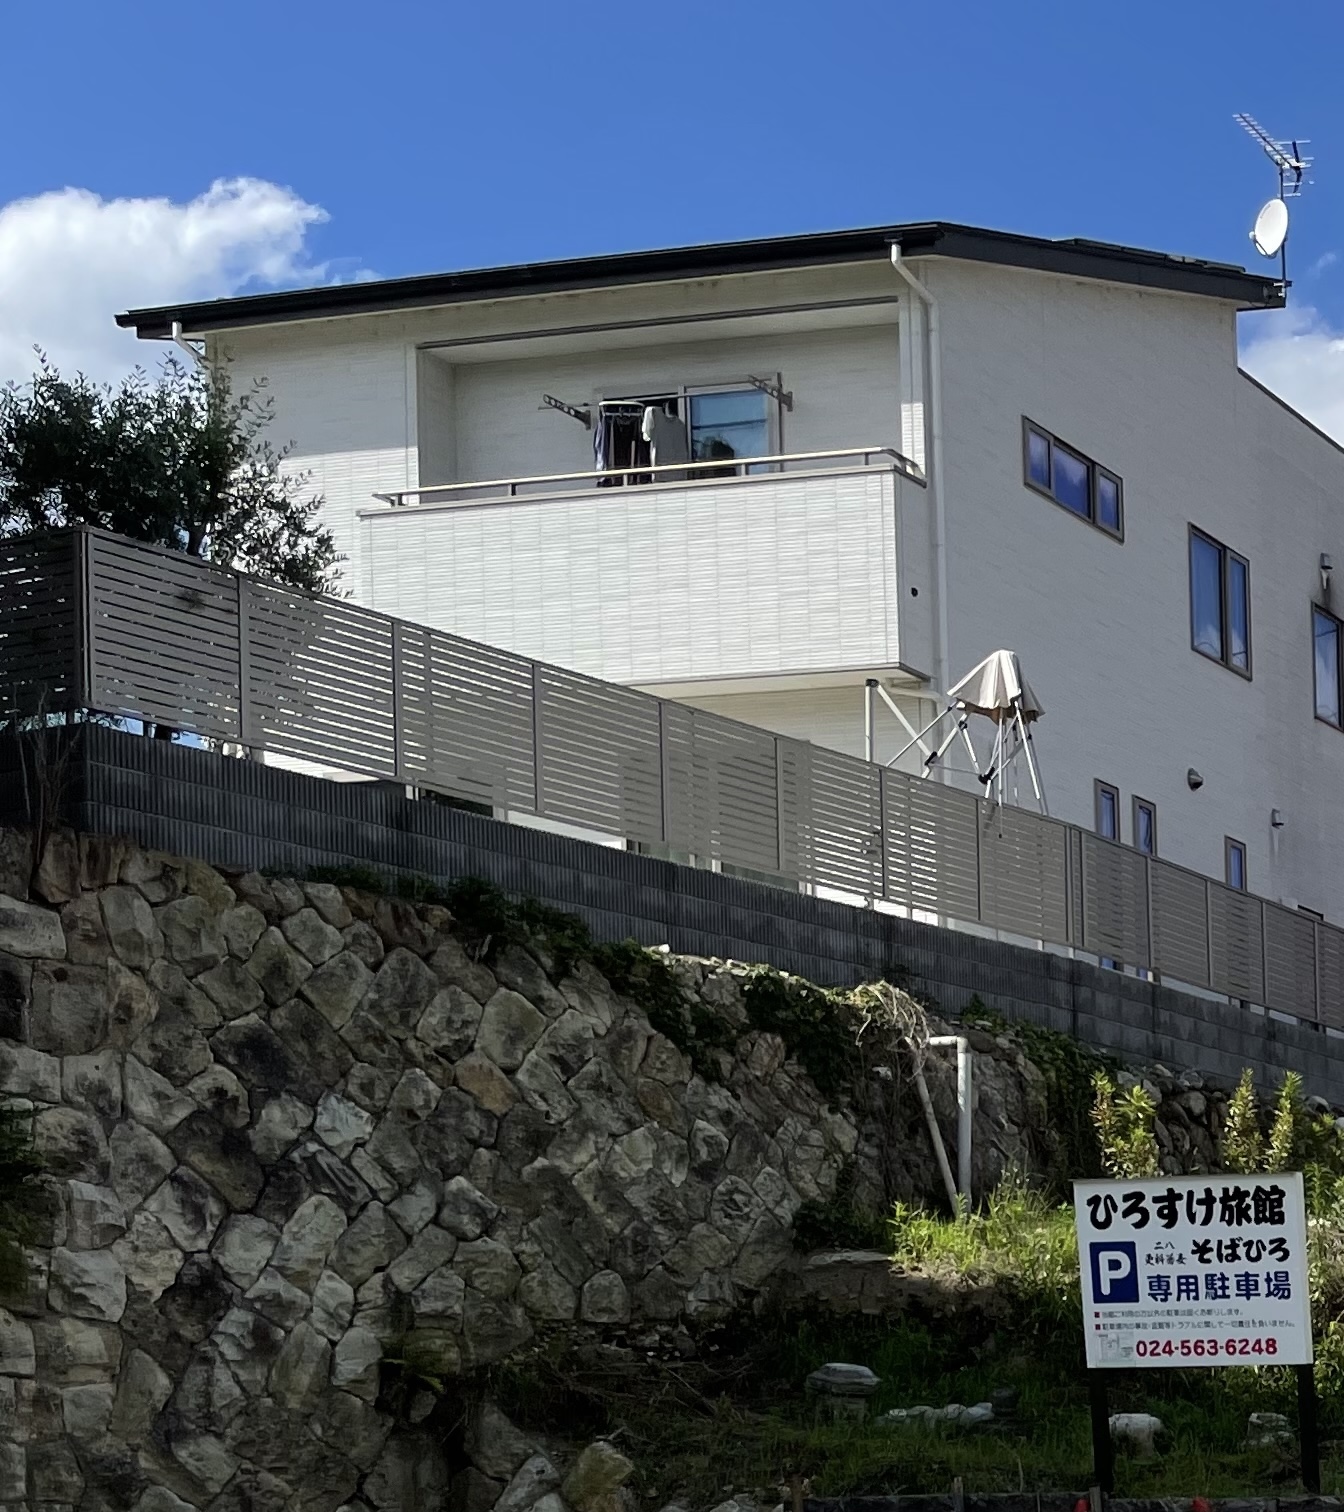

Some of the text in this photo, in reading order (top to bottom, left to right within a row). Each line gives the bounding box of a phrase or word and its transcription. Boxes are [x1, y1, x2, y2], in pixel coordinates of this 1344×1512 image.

[1086, 1184, 1287, 1230] ひろすけ旅館
[1190, 1236, 1291, 1264] そばひろ
[1098, 1250, 1131, 1296] P
[1147, 1270, 1292, 1302] 専用駐車場
[1136, 1337, 1278, 1358] 024-563-6248
